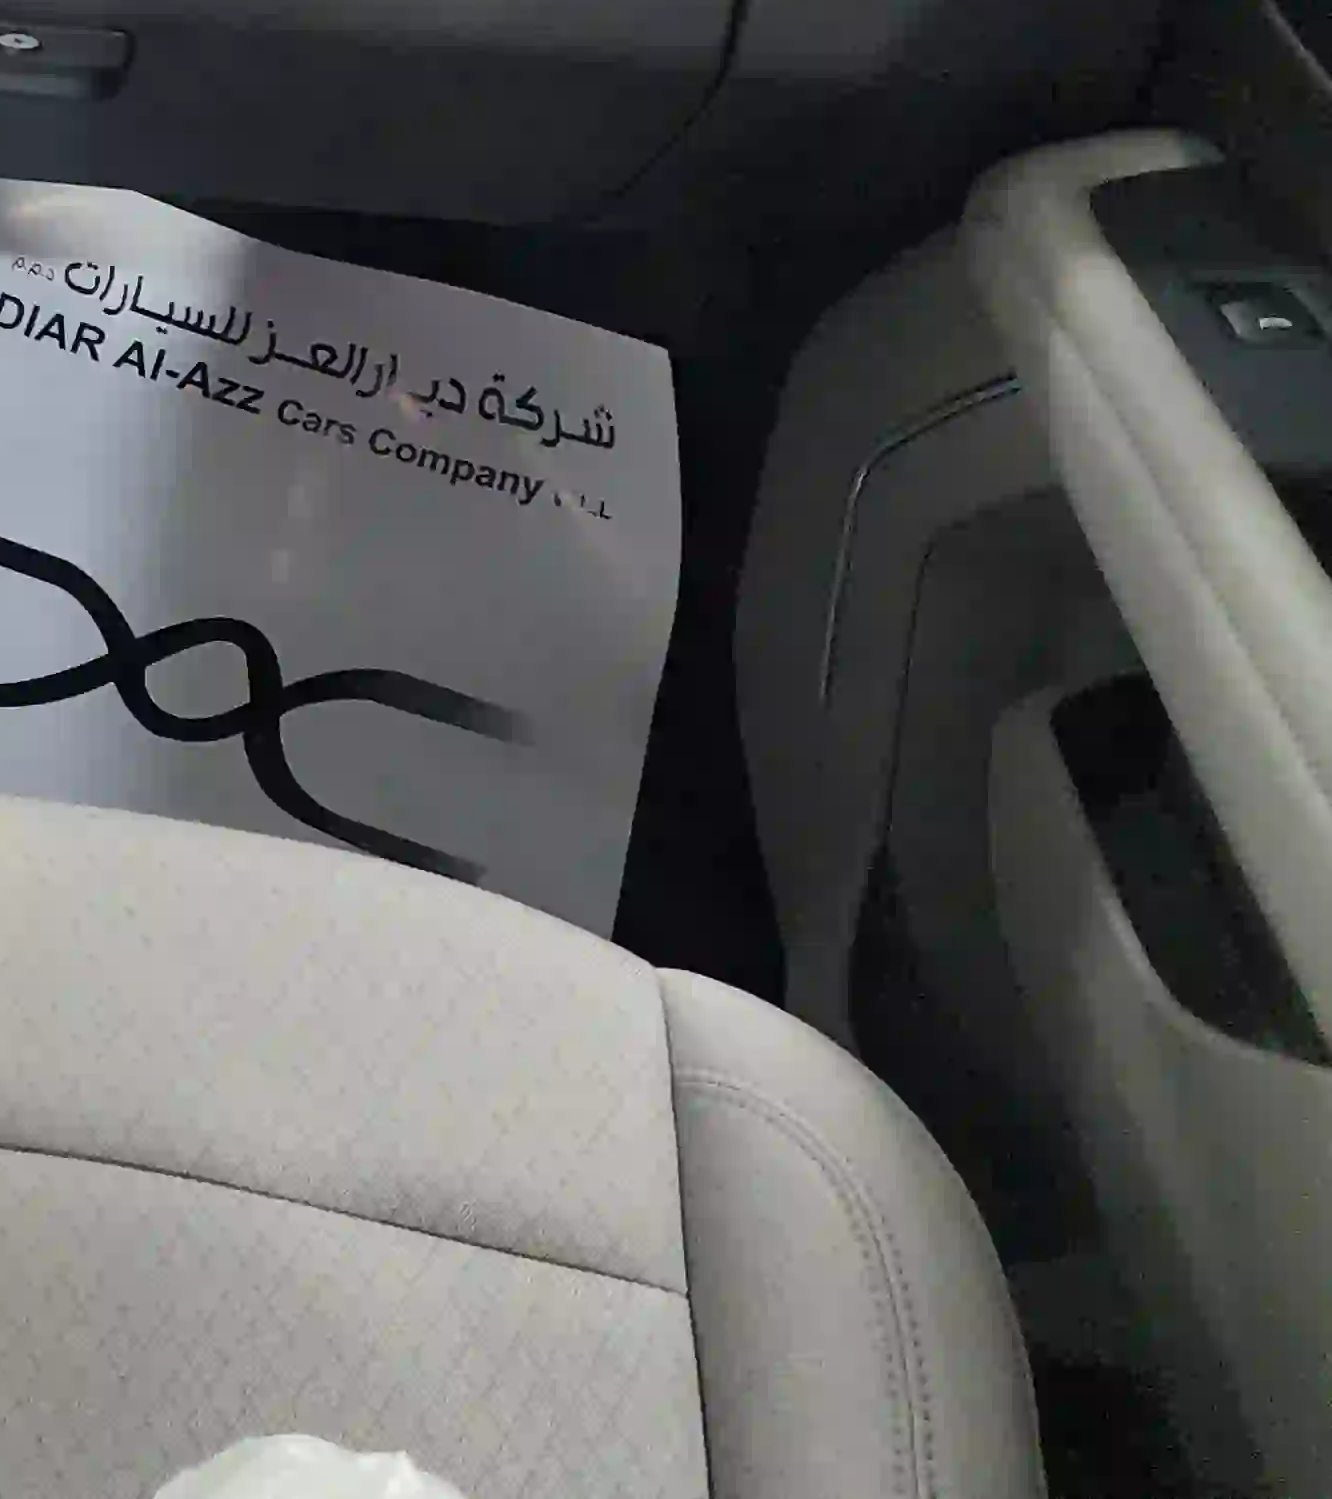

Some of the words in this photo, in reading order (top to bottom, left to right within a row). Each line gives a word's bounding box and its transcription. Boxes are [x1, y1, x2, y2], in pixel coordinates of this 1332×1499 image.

[64, 260, 253, 346] للسيارات
[111, 338, 265, 415] Al-Azz
[277, 398, 358, 446] Cars
[368, 427, 545, 506] Company
[478, 372, 616, 450] شركة
